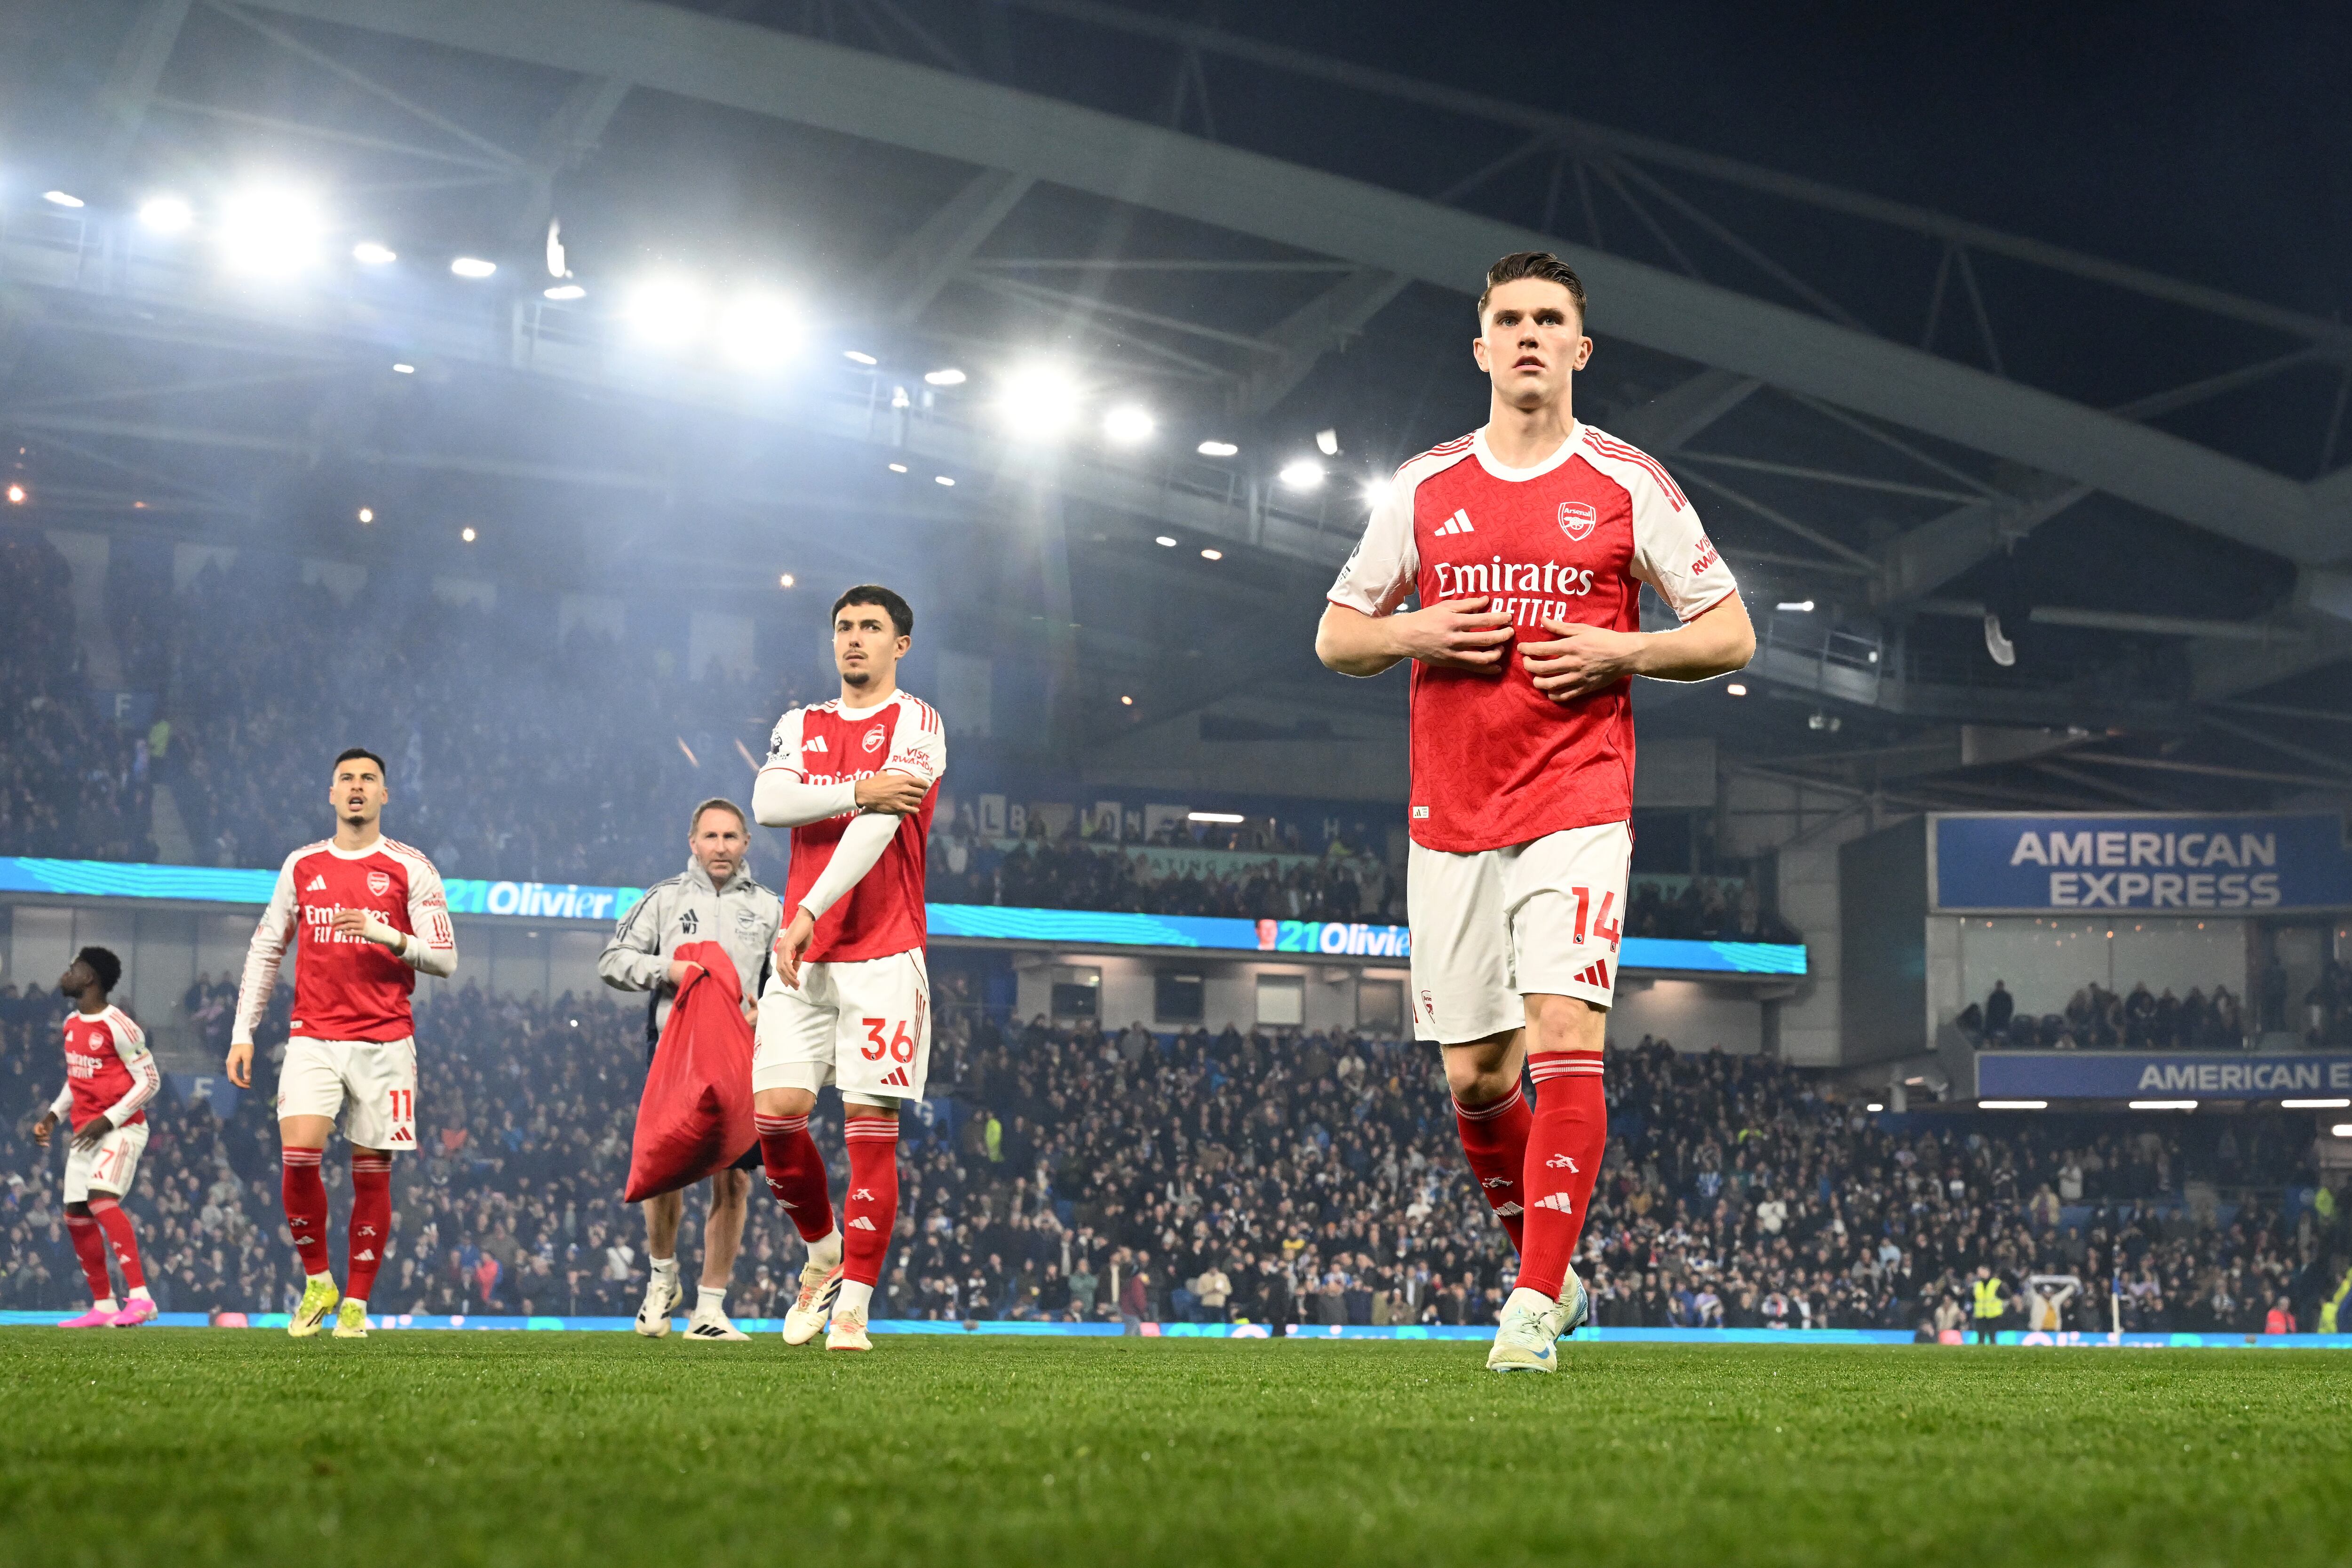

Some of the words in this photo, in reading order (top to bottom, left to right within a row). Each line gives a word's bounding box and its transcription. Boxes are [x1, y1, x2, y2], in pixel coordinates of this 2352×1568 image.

[1564, 508, 1591, 517] Arsenal
[1434, 555, 1594, 597] Emirates
[891, 755, 933, 776] RWANDA
[907, 747, 930, 761] VISIT
[2010, 831, 2276, 867] AMERICAN
[444, 878, 487, 913] 21
[486, 881, 612, 920] Olivier
[2050, 871, 2282, 907] EXPRESS
[682, 923, 697, 934] WJ
[1572, 887, 1620, 953] 14
[1277, 920, 1320, 953] 21
[860, 1018, 914, 1063] 36
[2138, 1063, 2320, 1090] AMERICAN
[389, 1090, 412, 1122] 11
[914, 1099, 934, 1128] G
[101, 1148, 115, 1168] 7
